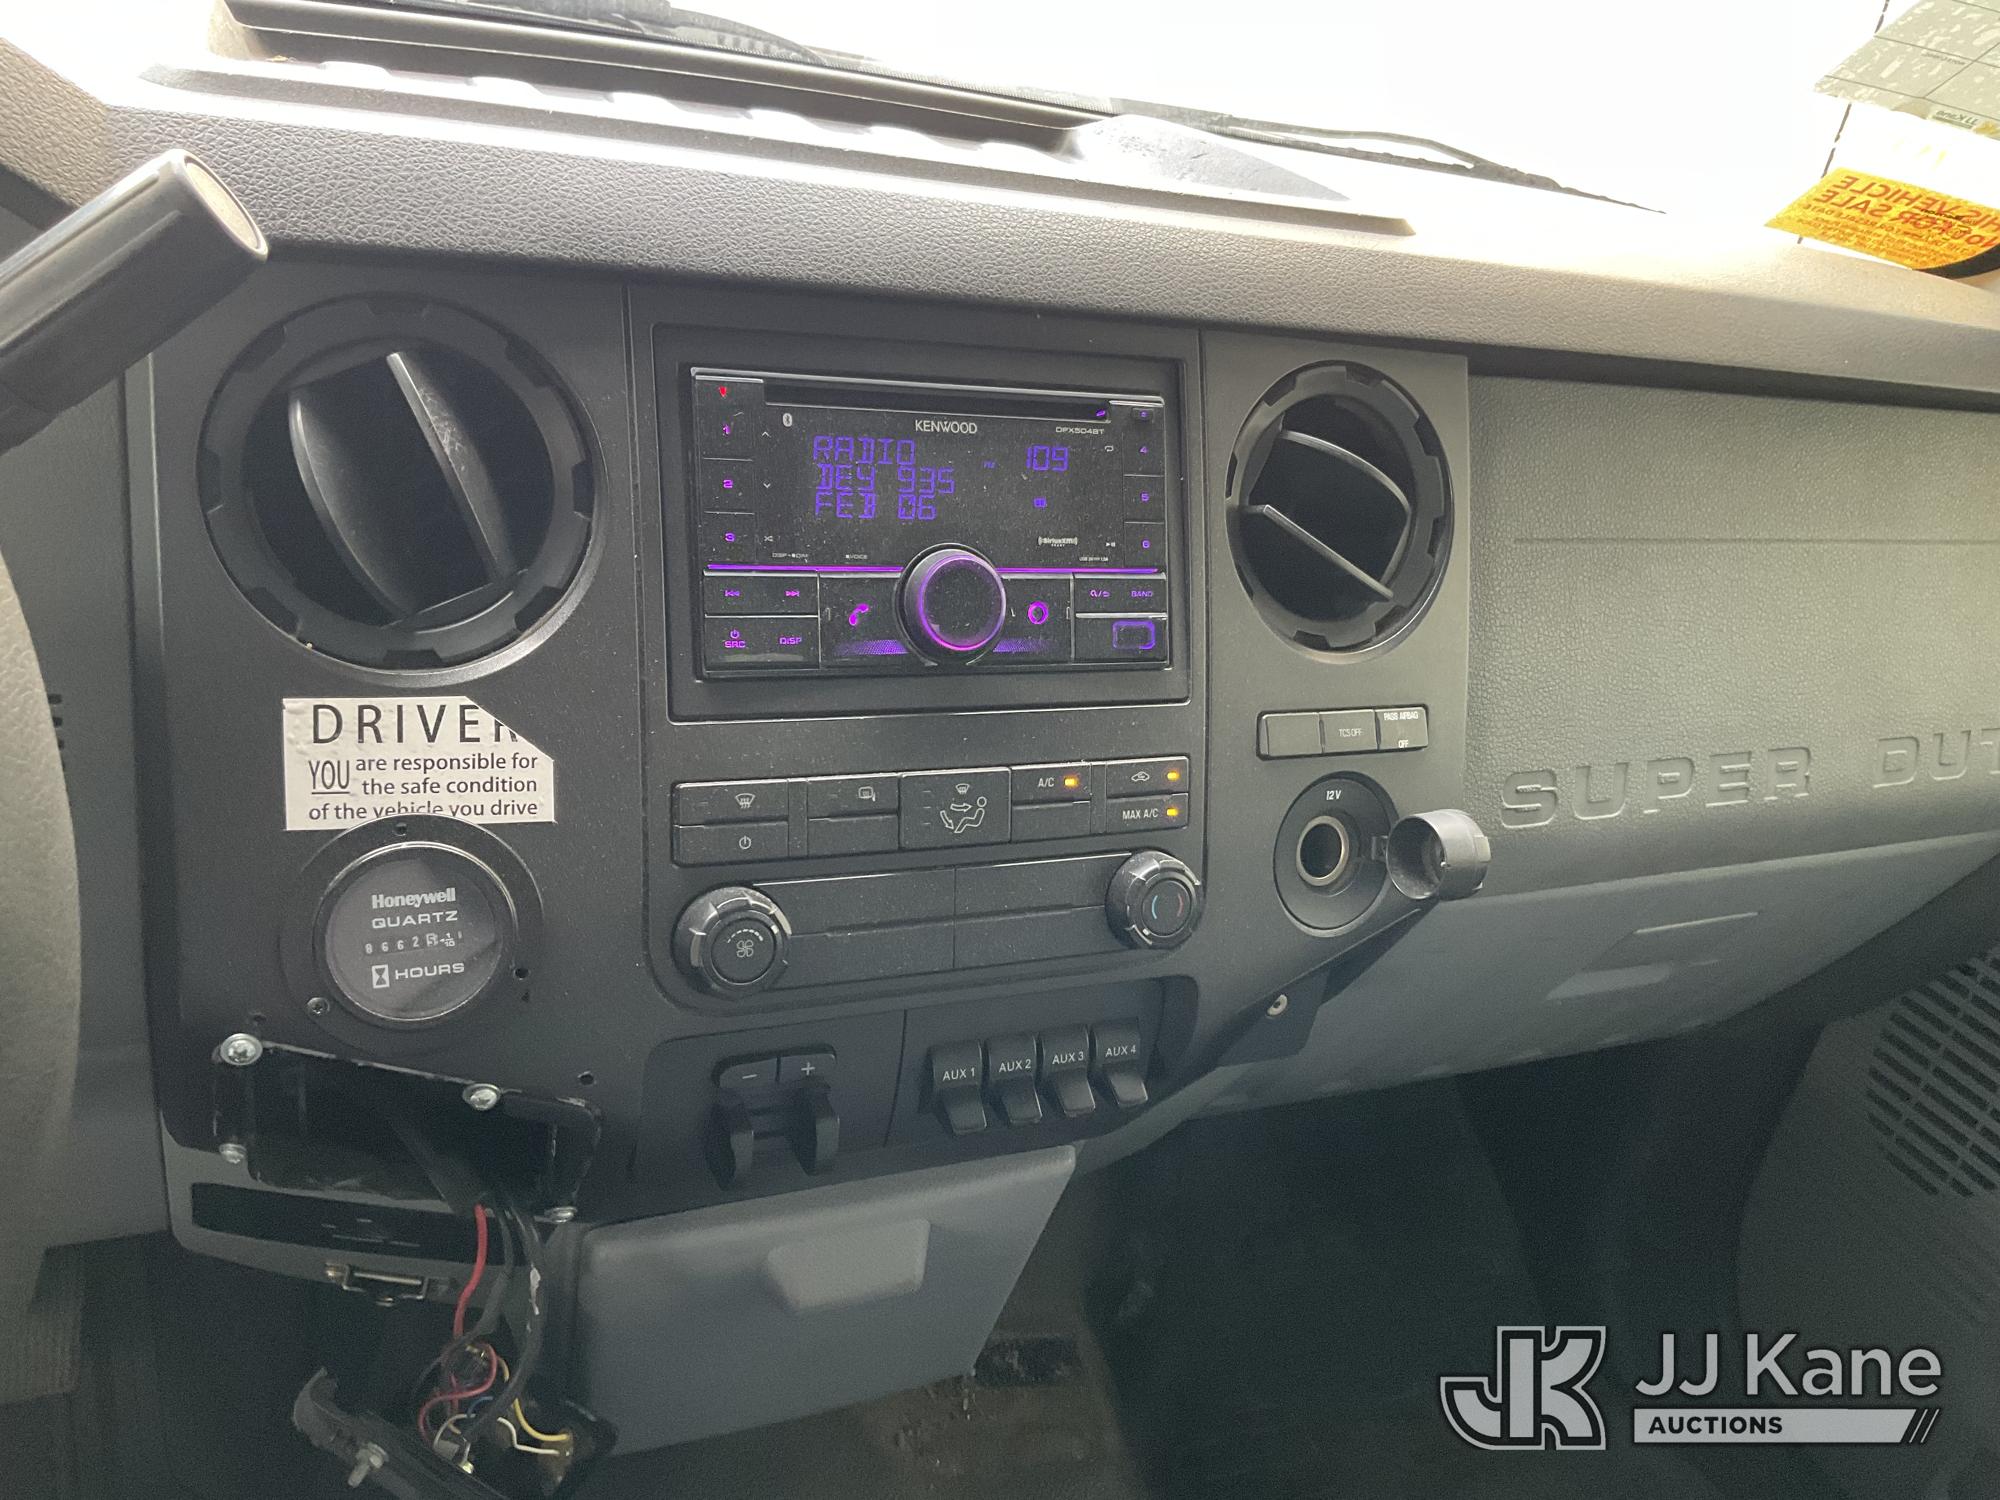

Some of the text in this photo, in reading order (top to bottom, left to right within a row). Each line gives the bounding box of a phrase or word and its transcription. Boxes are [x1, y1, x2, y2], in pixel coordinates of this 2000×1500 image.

[915, 419, 978, 434] KENWOOD
[813, 435, 916, 465] RADIO
[1139, 446, 1148, 454] 4
[1025, 444, 1070, 472] 109
[723, 479, 733, 489] 2
[897, 465, 955, 494] 935
[1140, 492, 1149, 502] 5
[897, 493, 937, 520] 06
[725, 532, 735, 542] 3
[724, 640, 746, 649] SRC
[779, 637, 802, 645] DISP
[1383, 711, 1419, 721] PASS AIRBAG
[1351, 727, 1363, 736] OFF
[1398, 739, 1409, 749] OFF
[308, 752, 538, 791] YOU are responsible for
[362, 776, 537, 795] the safe condition
[1037, 777, 1055, 788] A/C
[1500, 746, 1813, 829] SUPER
[309, 800, 538, 821] of the vehicle you drive
[1122, 808, 1159, 820] MAX A/C
[371, 887, 456, 909] Honeywell
[371, 910, 458, 929] QUARTZ
[395, 962, 465, 980] HOURS
[1105, 1044, 1137, 1057] AUX 4
[1052, 1051, 1084, 1065] AUX 3
[999, 1058, 1032, 1073] AUX 2
[942, 1067, 976, 1081] AUX 1
